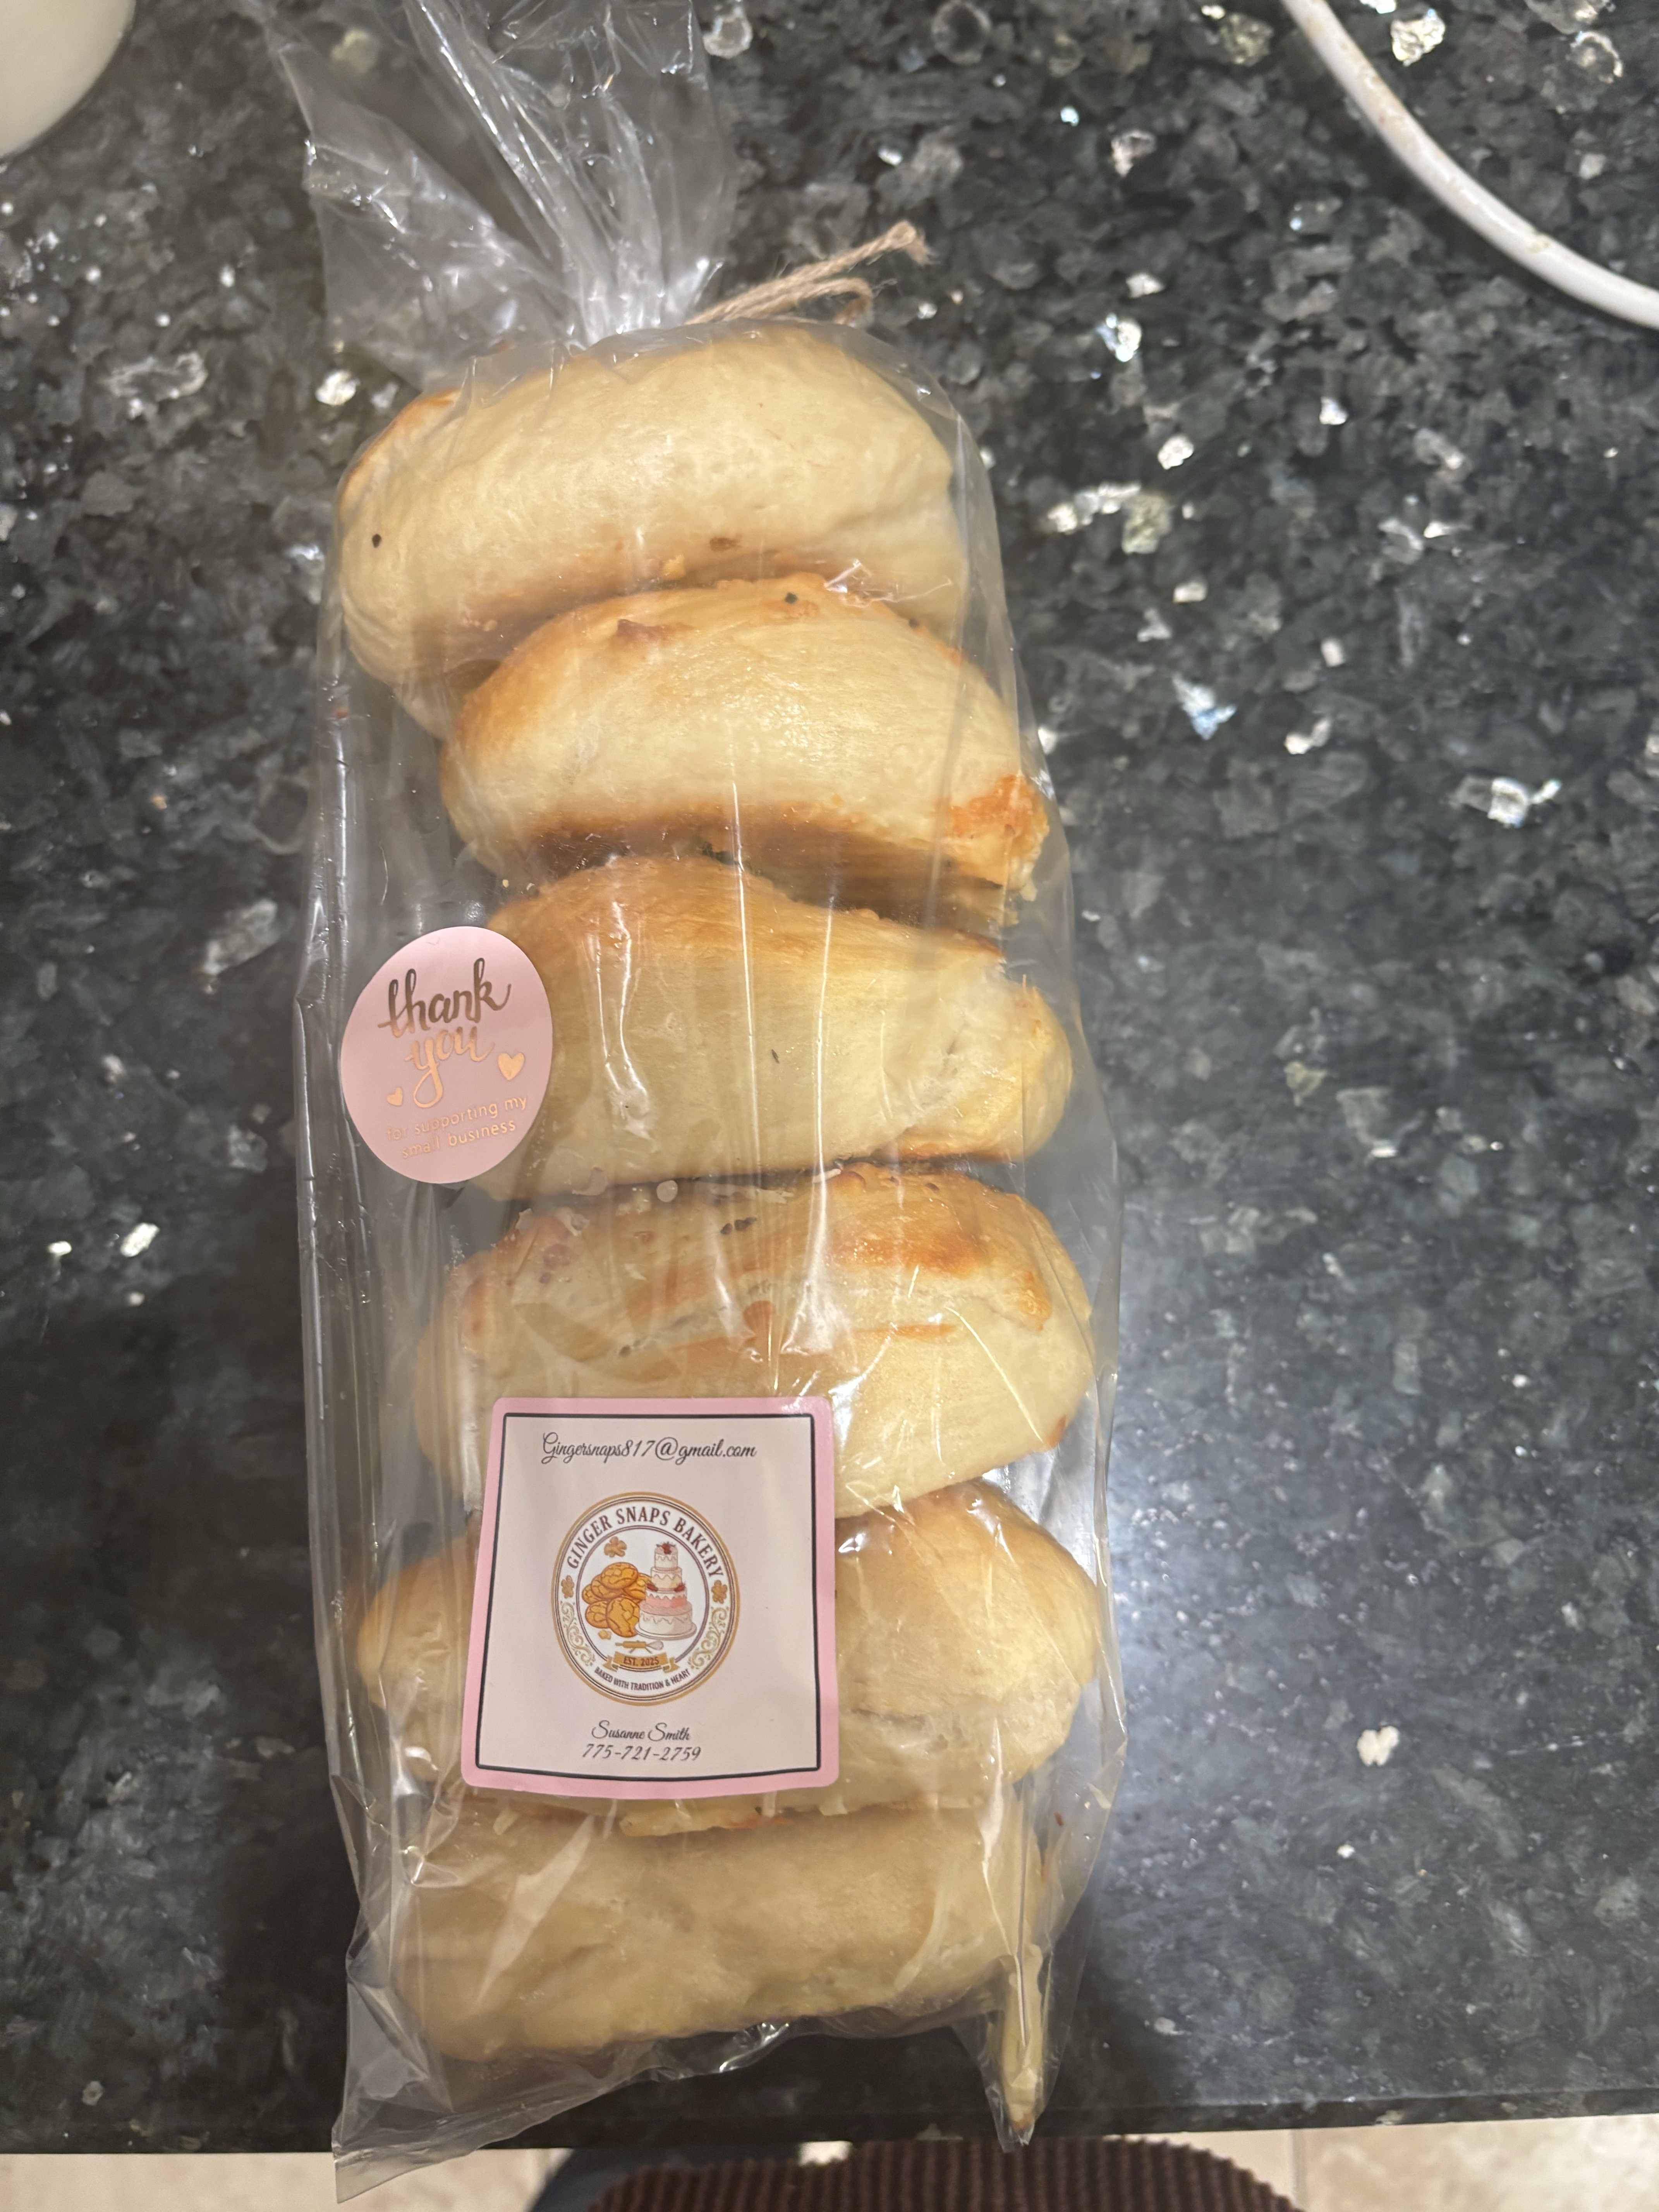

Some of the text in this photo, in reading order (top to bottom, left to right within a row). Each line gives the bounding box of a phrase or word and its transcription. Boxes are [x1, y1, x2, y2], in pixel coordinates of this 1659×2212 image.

[378, 957, 512, 1038] thank
[405, 1026, 495, 1108] you
[387, 1096, 527, 1140] for supporting my
[402, 1120, 516, 1159] small business
[541, 1431, 757, 1465] Gingersnaps817@gmail.com
[567, 1506, 724, 1578] GINGER SNAPS BAKERY
[594, 1666, 691, 1691] BAKED WITH TRADITION & HEART
[623, 1656, 660, 1666] EST. 2025
[591, 1720, 690, 1741] Susanne Smith
[582, 1743, 702, 1761] 775-721-2759
